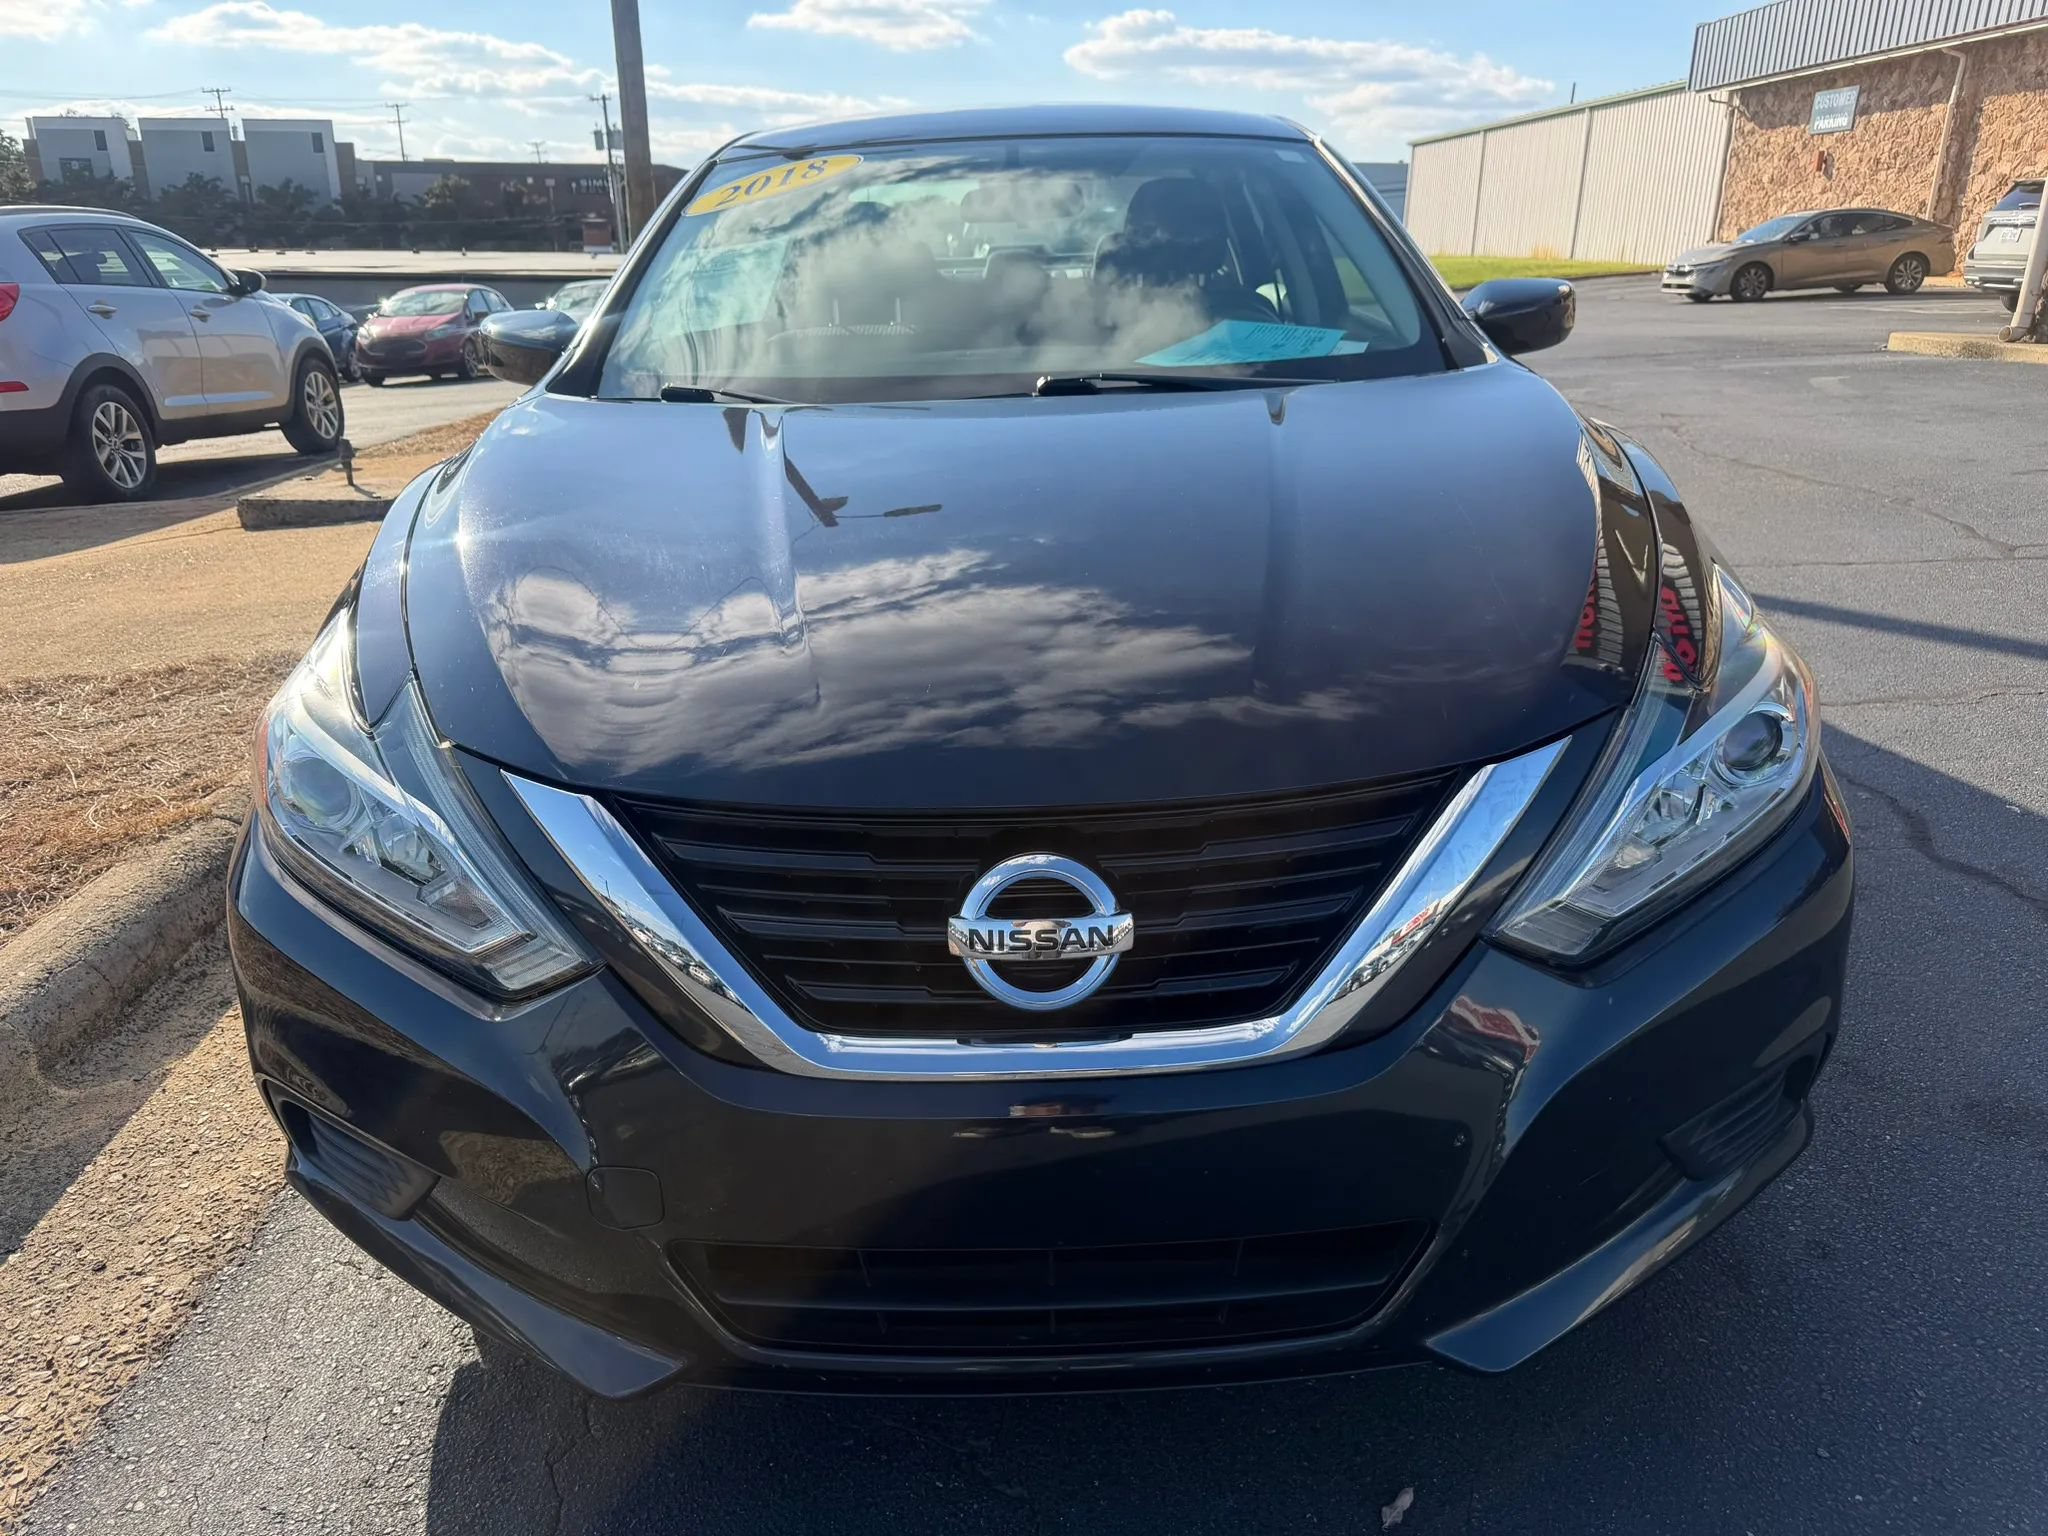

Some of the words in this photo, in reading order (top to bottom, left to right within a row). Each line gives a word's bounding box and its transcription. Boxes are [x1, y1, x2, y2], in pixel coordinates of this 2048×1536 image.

[1815, 90, 1857, 109] CUSTOMER
[1814, 112, 1849, 130] PARKING
[714, 159, 828, 207] 2018
[968, 925, 1114, 952] NISSAN
